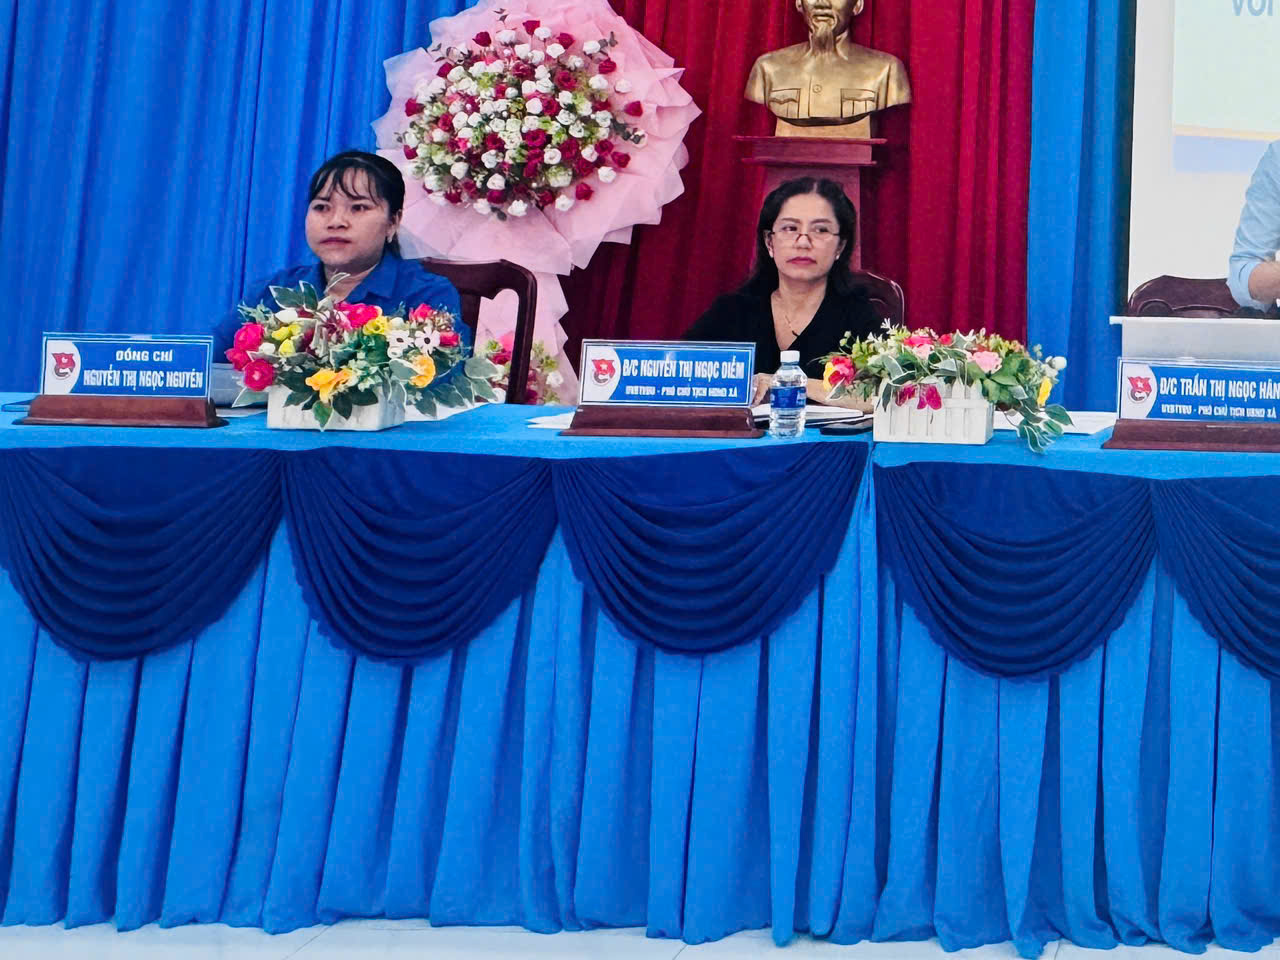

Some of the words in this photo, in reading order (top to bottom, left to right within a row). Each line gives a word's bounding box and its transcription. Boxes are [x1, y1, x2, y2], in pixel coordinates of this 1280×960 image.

[153, 349, 173, 362] CHÍ
[122, 369, 137, 391] THỊ
[139, 370, 164, 391] NGỌC
[679, 360, 693, 382] THỊ
[695, 360, 720, 383] NGỌC
[1159, 377, 1177, 395] Đ/C
[1210, 379, 1226, 401] THỊ
[1228, 380, 1257, 402] NGỌC
